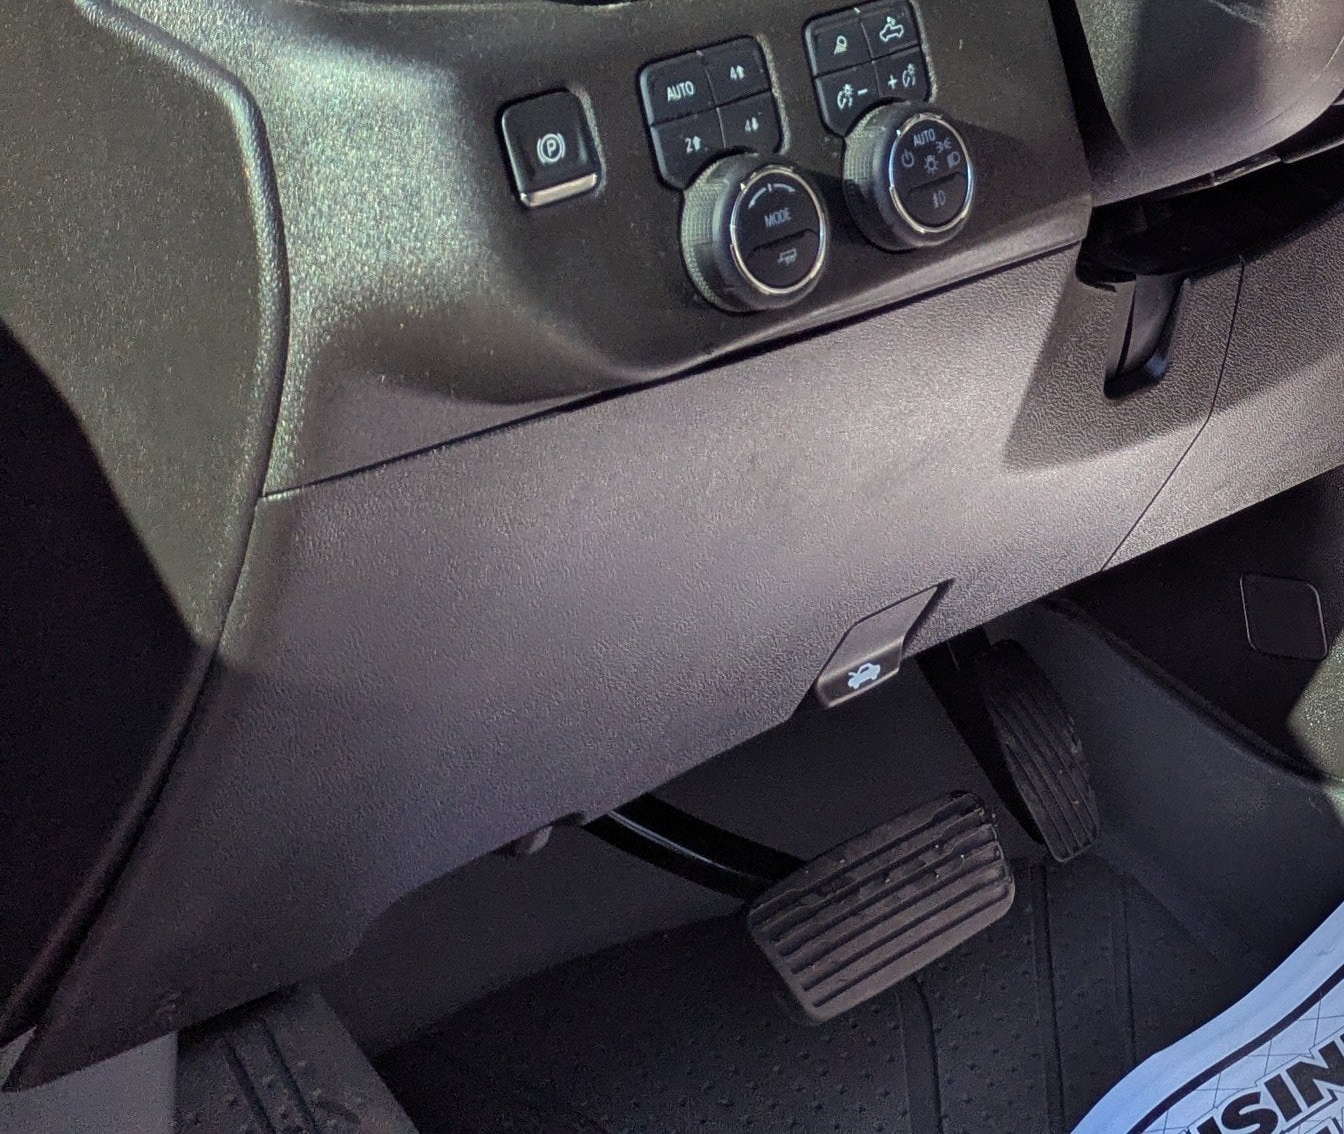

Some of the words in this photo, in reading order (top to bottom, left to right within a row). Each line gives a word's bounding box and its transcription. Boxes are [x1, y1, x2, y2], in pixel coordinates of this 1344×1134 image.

[666, 80, 696, 102] AUTO
[913, 128, 936, 147] AUTO
[764, 207, 792, 228] MODE
